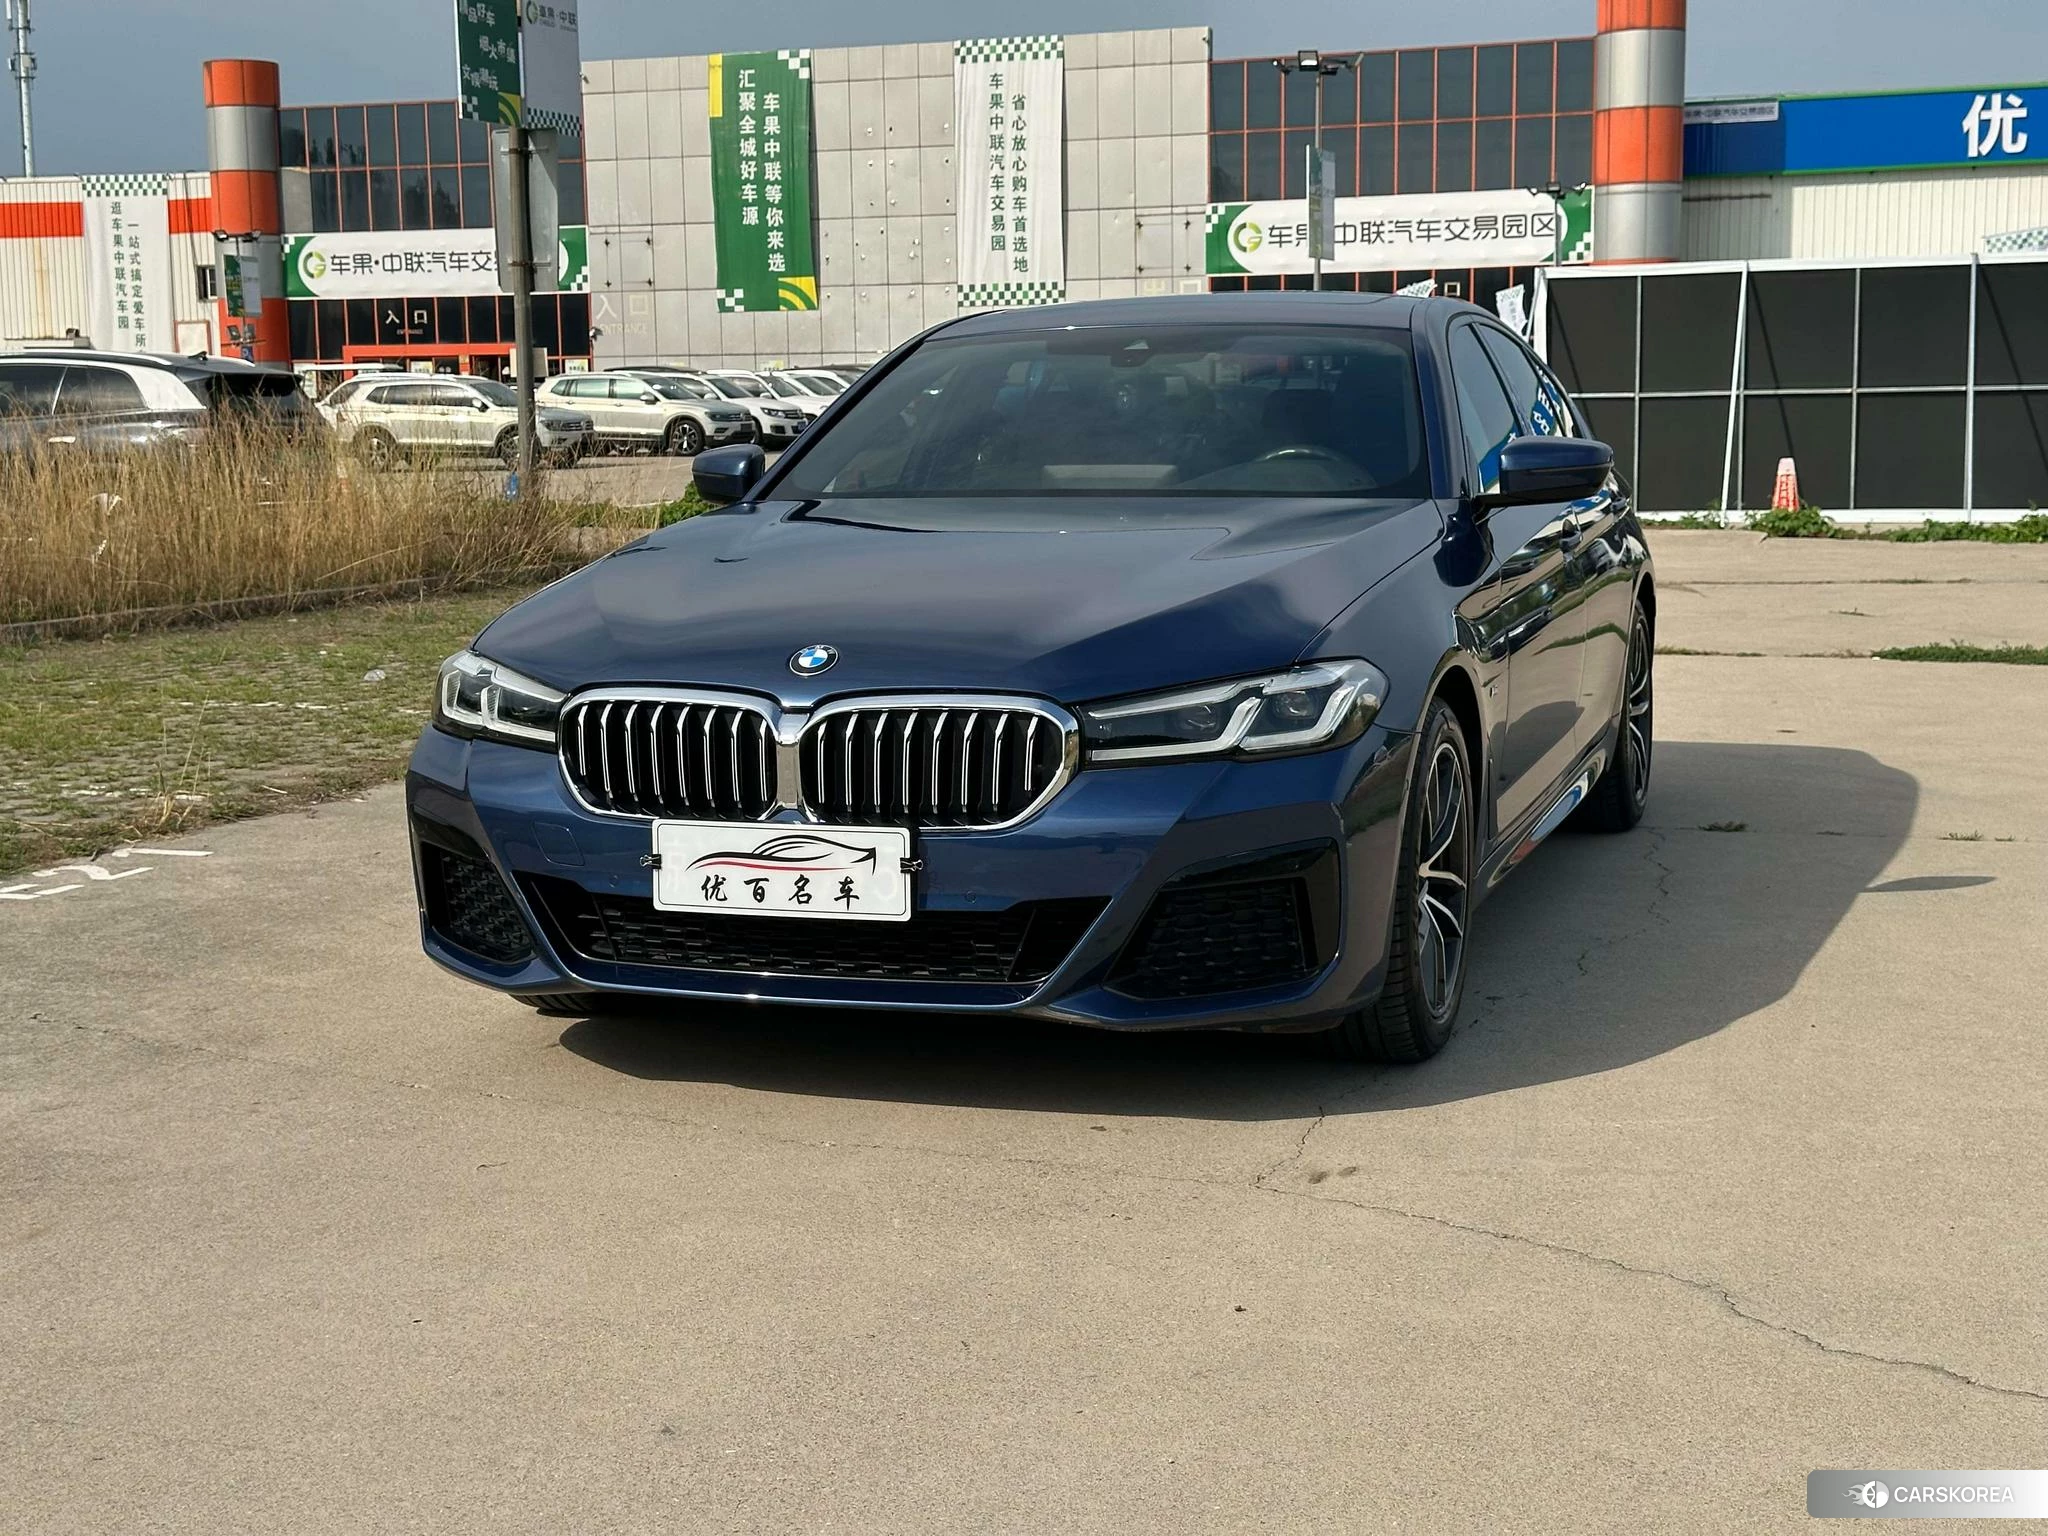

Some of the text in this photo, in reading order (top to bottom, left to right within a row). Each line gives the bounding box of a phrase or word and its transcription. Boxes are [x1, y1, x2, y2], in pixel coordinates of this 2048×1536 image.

[738, 69, 759, 226] 汇聚全城好车源
[763, 92, 786, 272] 车果中联等你来选
[989, 73, 1006, 251] 车果中联汽车交易园
[1011, 93, 1029, 273] 省心放心购车首选地
[1962, 92, 2028, 158] 优
[110, 201, 129, 329] 逛车果中联汽车园
[127, 223, 146, 352] 一站式搞定爱车所
[330, 250, 499, 275] 车果·中联汽车交
[385, 310, 428, 324] 入口
[595, 294, 649, 320] 入口
[700, 874, 860, 911] 优百名车
